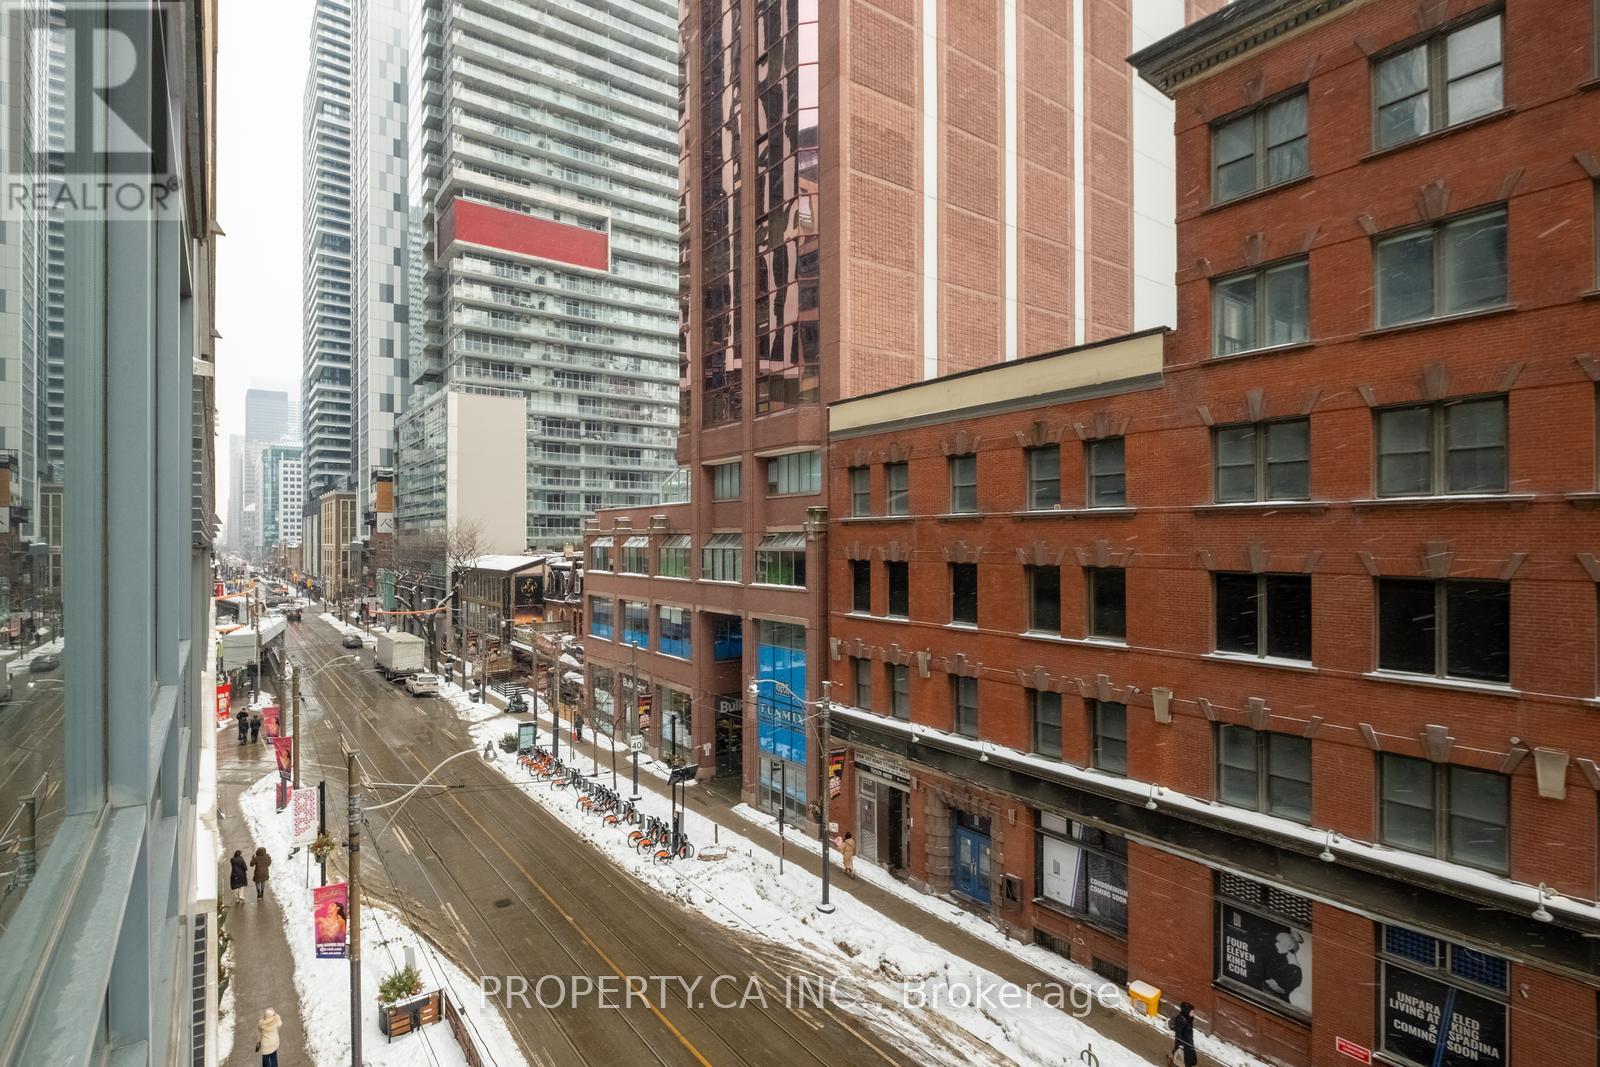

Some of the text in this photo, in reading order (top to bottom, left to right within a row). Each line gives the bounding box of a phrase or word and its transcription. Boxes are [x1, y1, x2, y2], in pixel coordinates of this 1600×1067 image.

[632, 741, 642, 749] 40
[1226, 936, 1248, 952] FOUR
[1226, 945, 1255, 963] ELEVEN
[1226, 953, 1247, 968] KING
[1389, 998, 1479, 1041] LIVING AT KING
[1393, 1018, 1478, 1061] COMING SOON
[1429, 1024, 1500, 1059] & SPADINA
